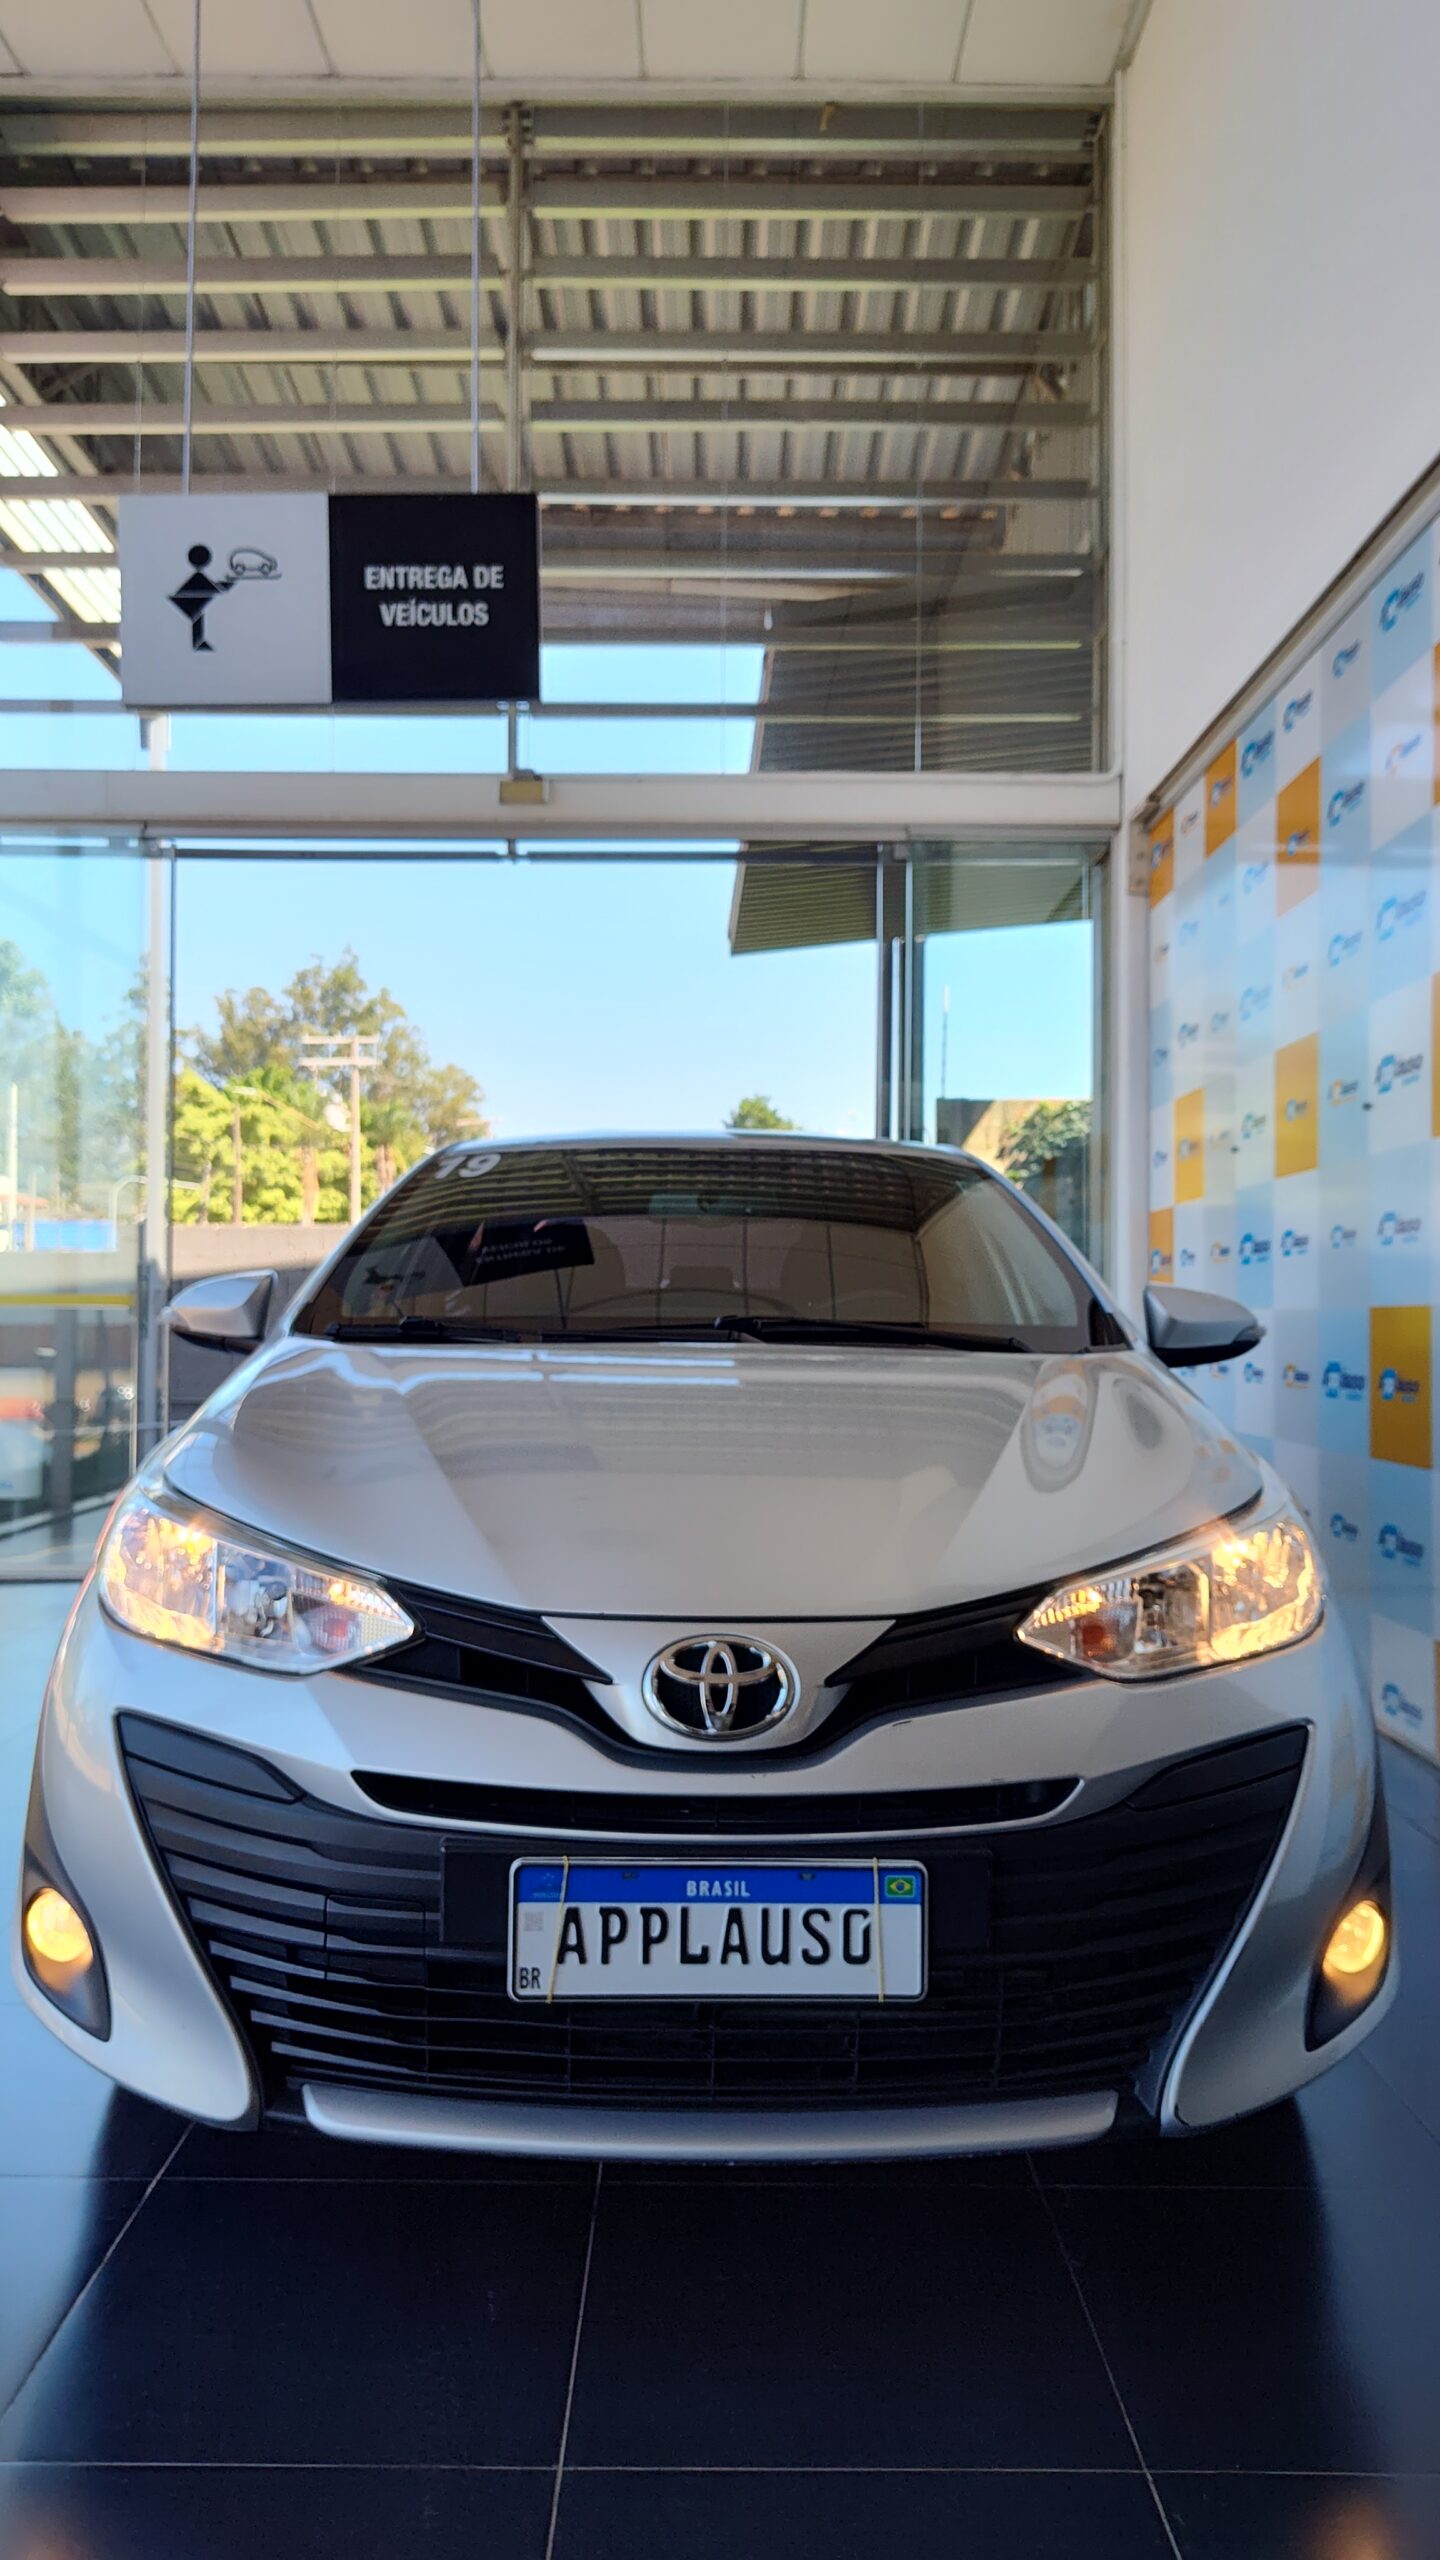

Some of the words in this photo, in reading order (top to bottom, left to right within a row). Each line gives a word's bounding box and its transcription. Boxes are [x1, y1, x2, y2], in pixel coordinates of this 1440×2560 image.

[364, 565, 469, 591] ENTREGA
[473, 565, 504, 590] DE
[379, 597, 489, 627] VEÍCULOS
[433, 1153, 502, 1179] 19
[686, 1880, 750, 1897] BRASIL
[557, 1906, 872, 1965] APPLAUSO
[519, 1968, 541, 1990] BR
